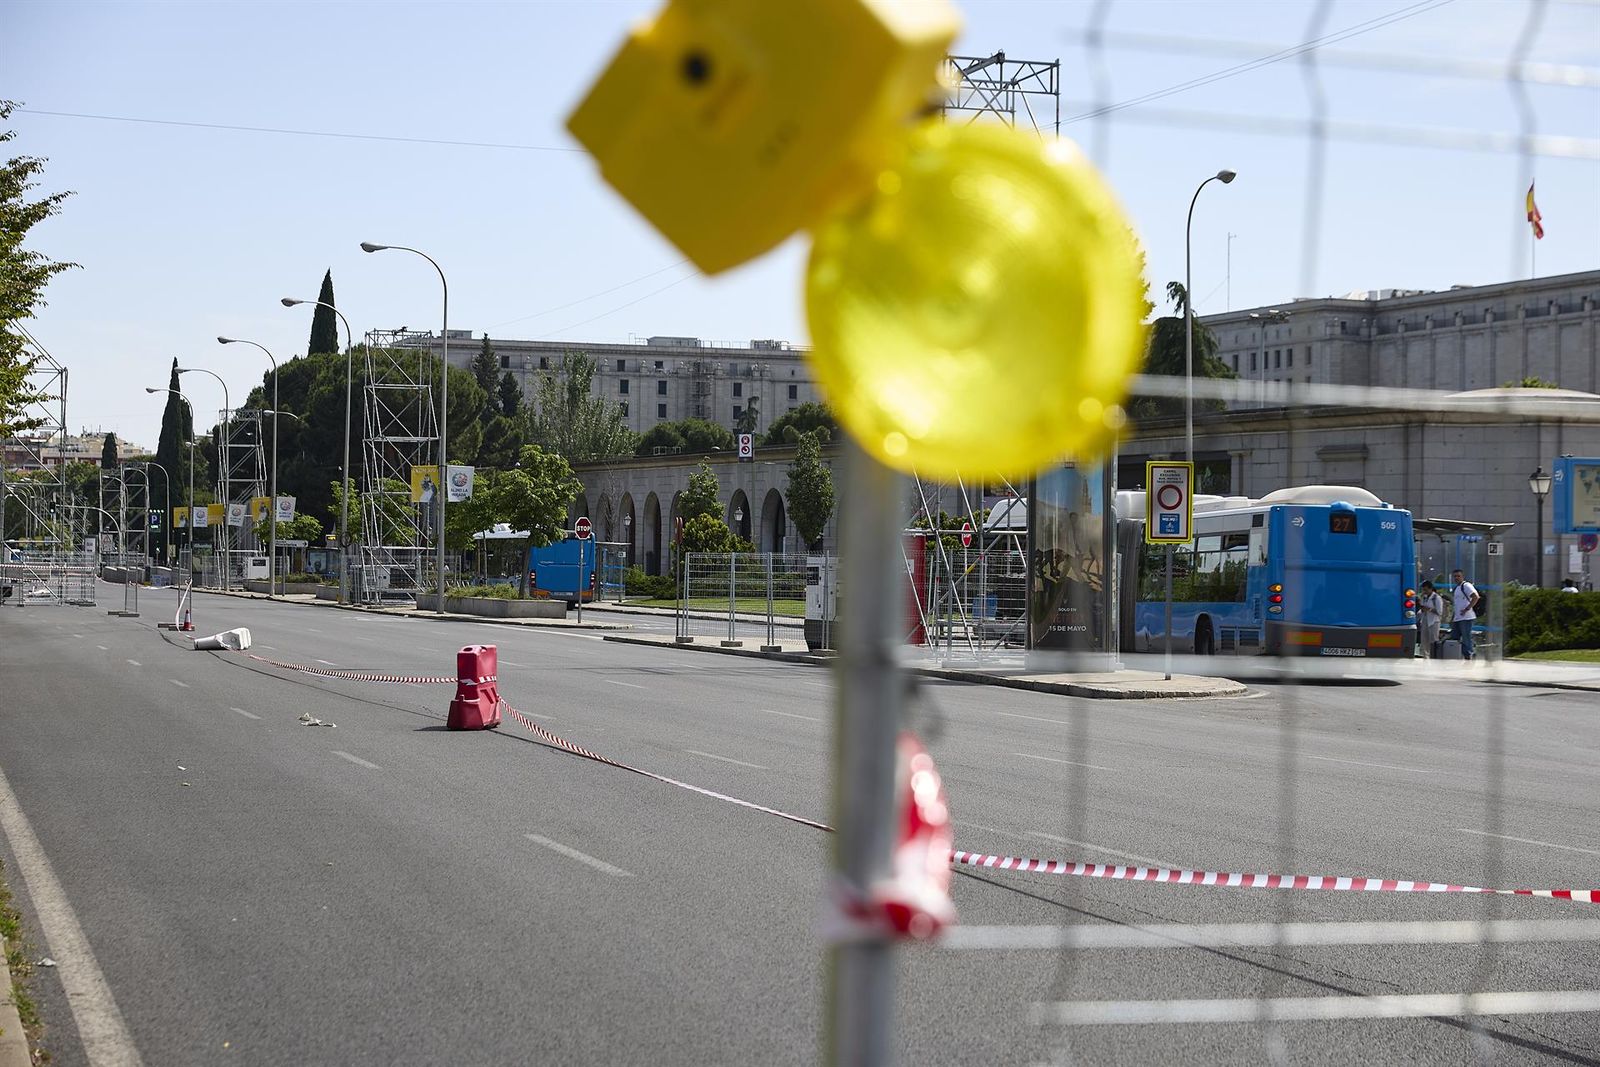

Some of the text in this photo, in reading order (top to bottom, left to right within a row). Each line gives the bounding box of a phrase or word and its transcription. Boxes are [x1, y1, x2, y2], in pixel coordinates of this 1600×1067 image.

[151, 515, 158, 524] P
[1333, 517, 1350, 532] 27
[1380, 521, 1396, 530] 505
